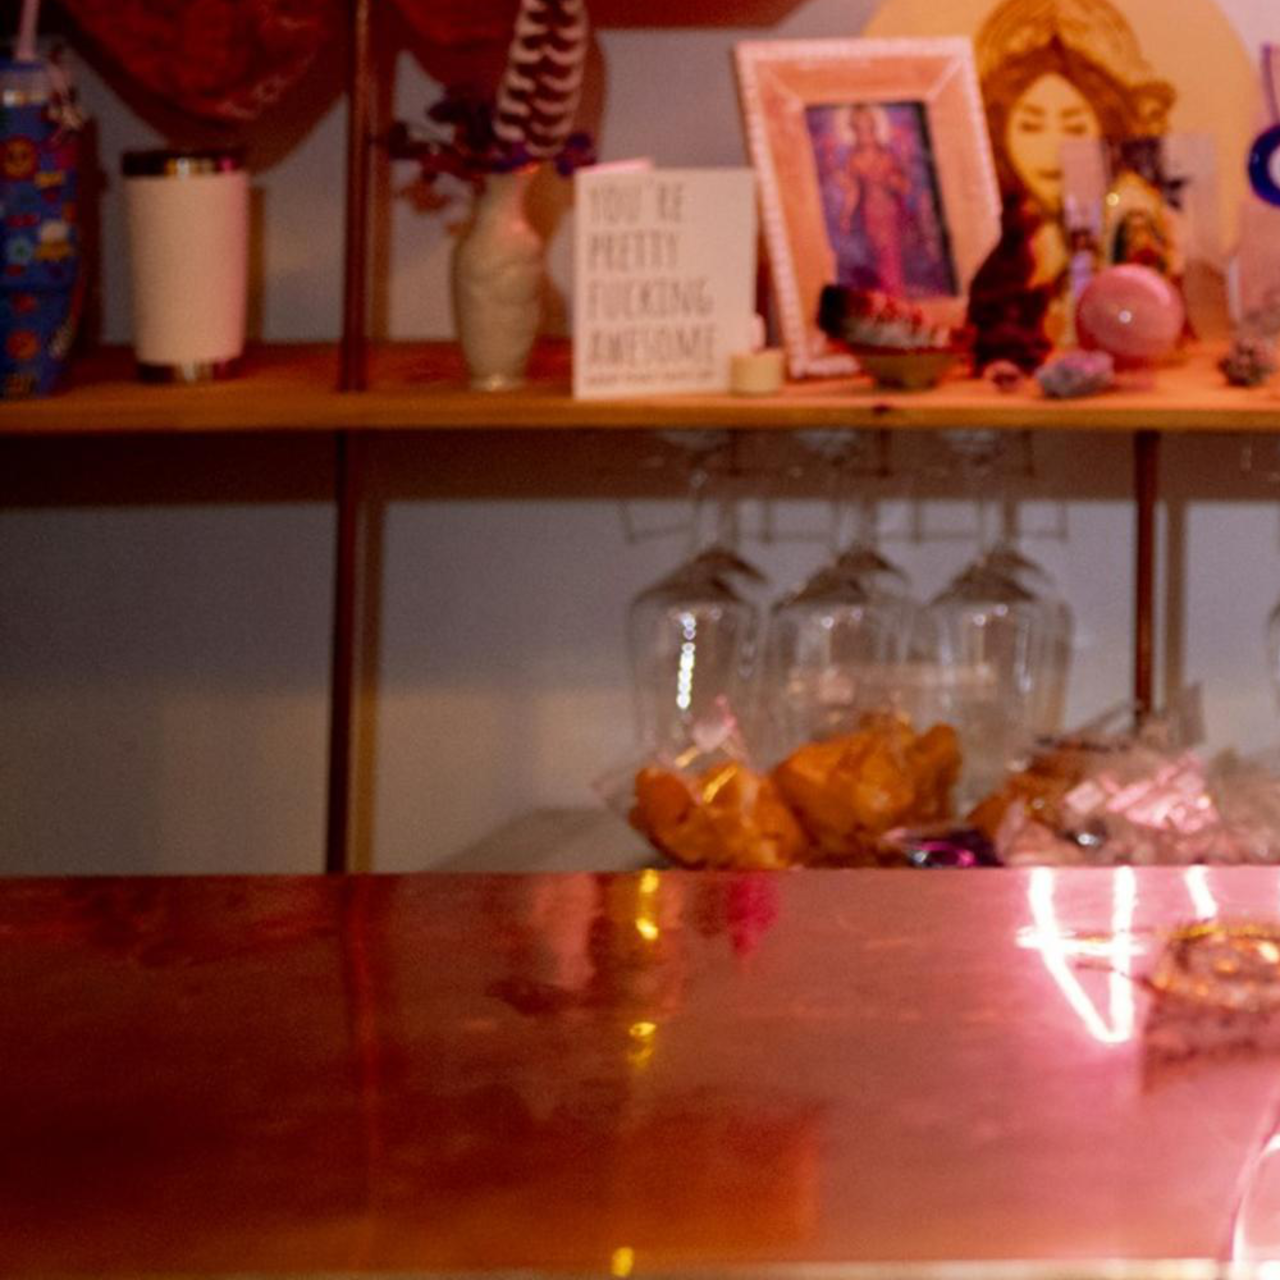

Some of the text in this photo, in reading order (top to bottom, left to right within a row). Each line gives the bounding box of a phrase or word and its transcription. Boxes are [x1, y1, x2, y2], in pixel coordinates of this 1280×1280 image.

[587, 229, 679, 272] PRETTY
[586, 276, 717, 322] FUCKING
[586, 323, 718, 370] AWESOME
